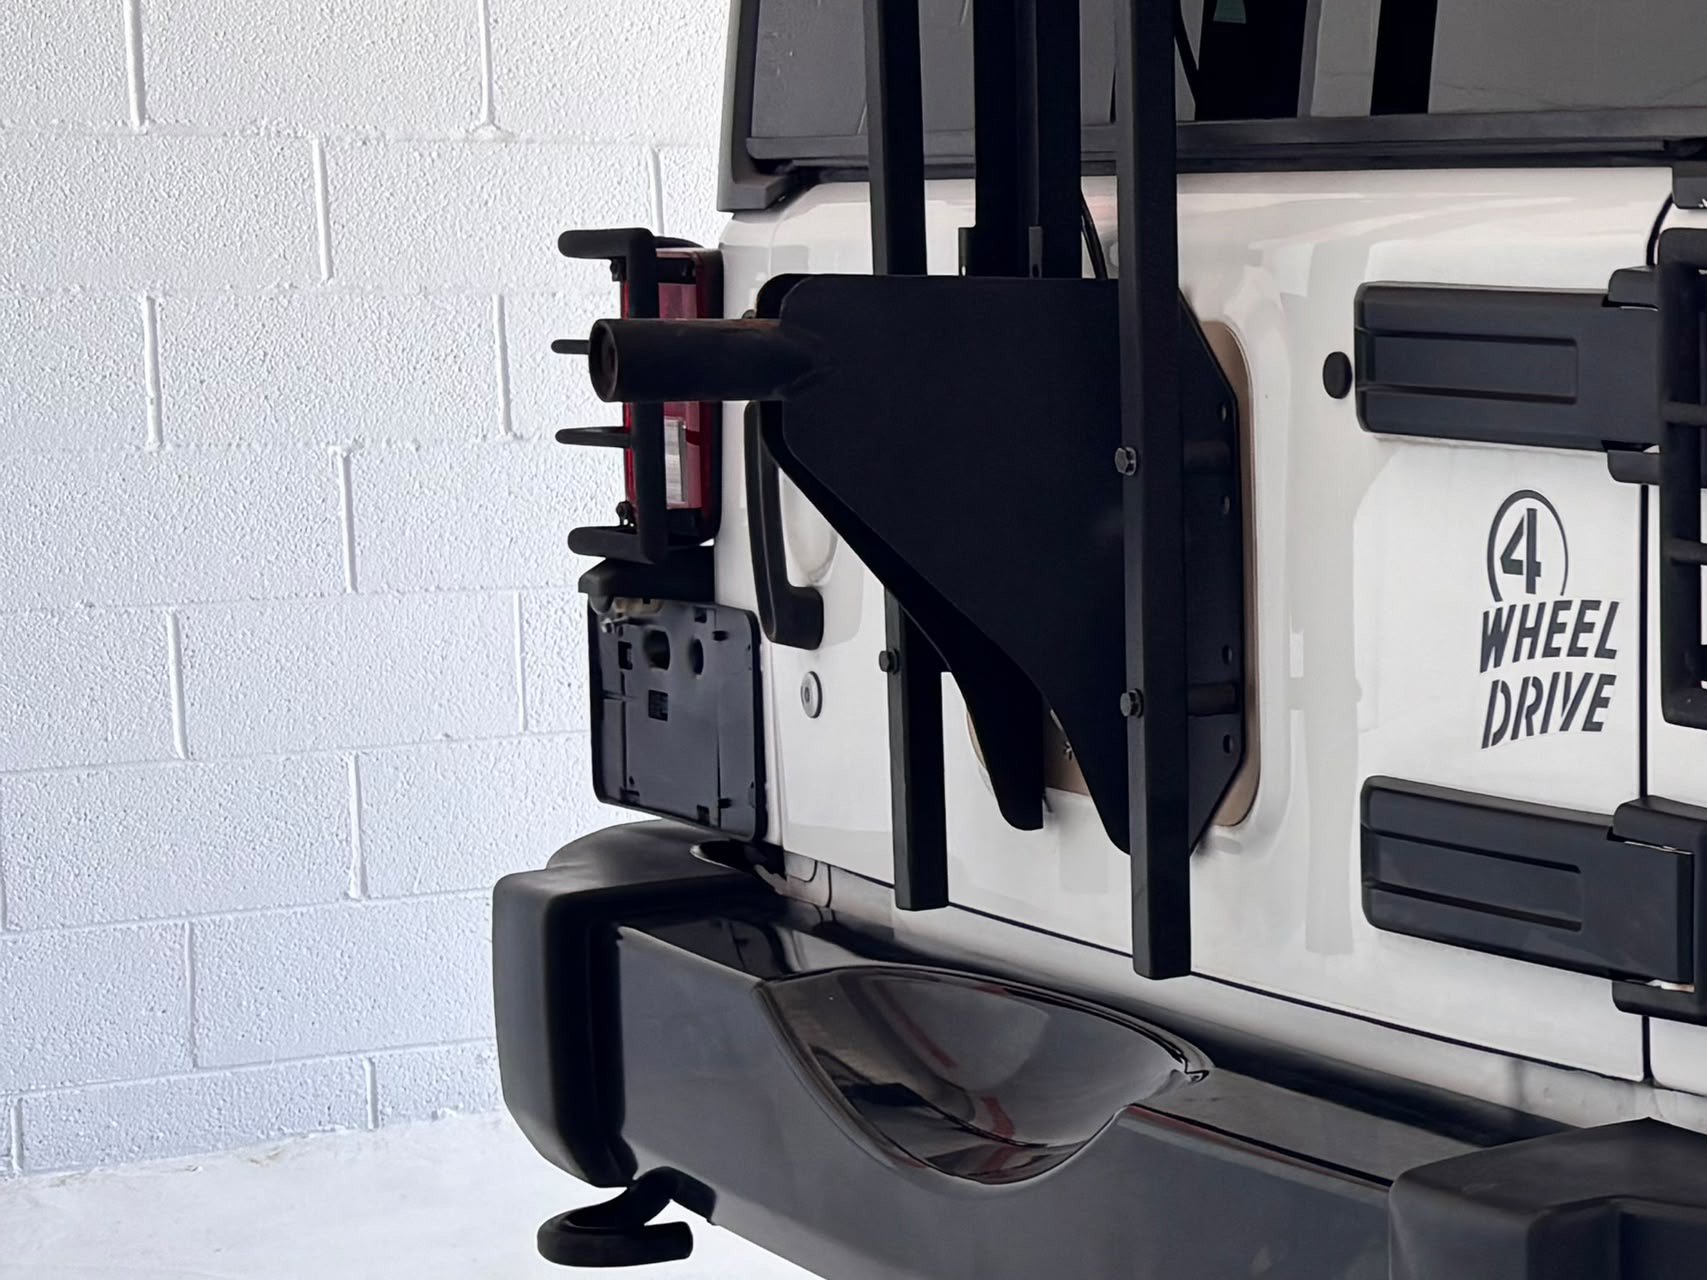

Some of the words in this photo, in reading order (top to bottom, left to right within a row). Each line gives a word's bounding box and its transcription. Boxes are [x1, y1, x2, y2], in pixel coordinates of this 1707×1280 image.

[1500, 508, 1542, 595] 4
[1480, 600, 1620, 674] WHEEL
[1481, 671, 1617, 749] DRIVE
